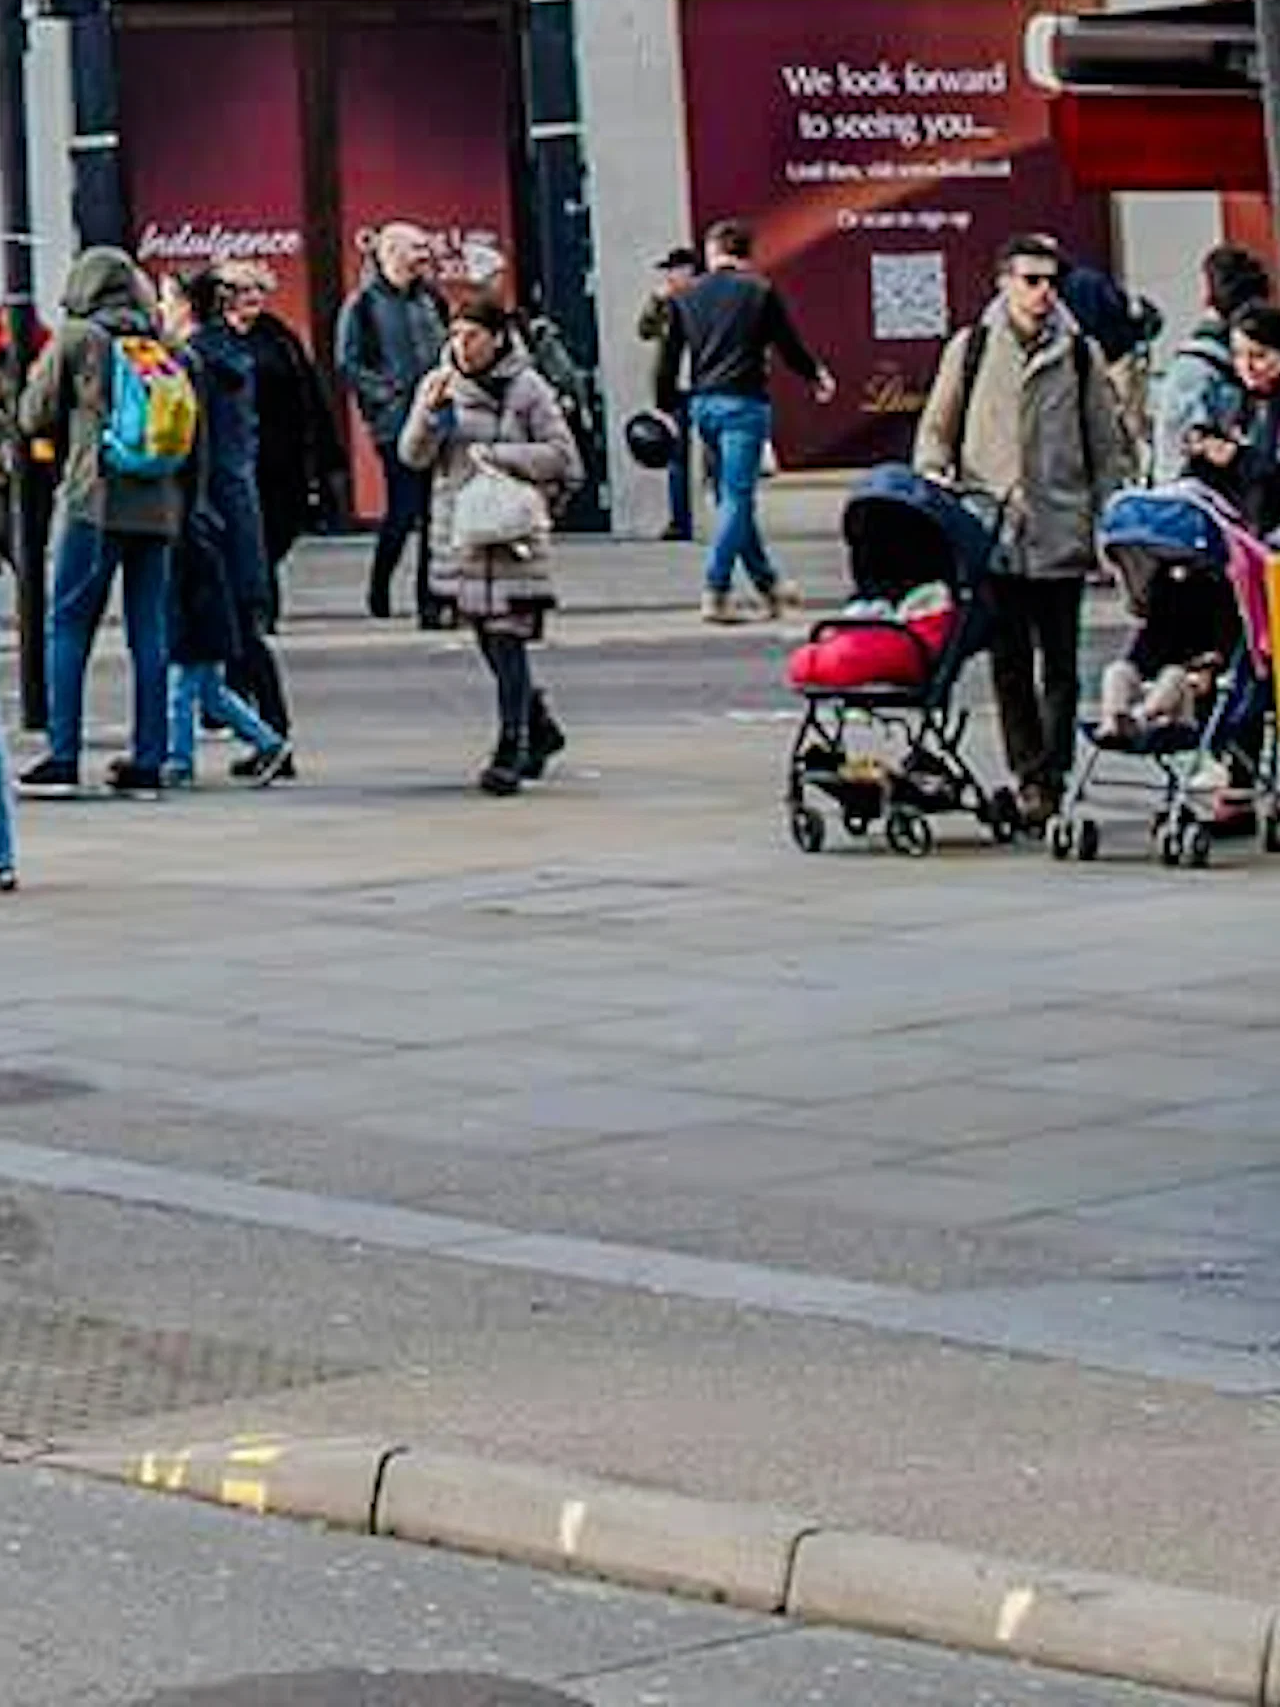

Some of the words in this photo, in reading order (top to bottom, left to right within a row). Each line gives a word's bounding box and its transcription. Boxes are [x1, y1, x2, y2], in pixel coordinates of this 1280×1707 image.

[782, 66, 833, 95] We
[837, 62, 899, 95] look
[905, 60, 1007, 94] forward
[798, 112, 828, 139] to
[833, 108, 919, 149] seeing
[138, 222, 301, 261] Indulgence
